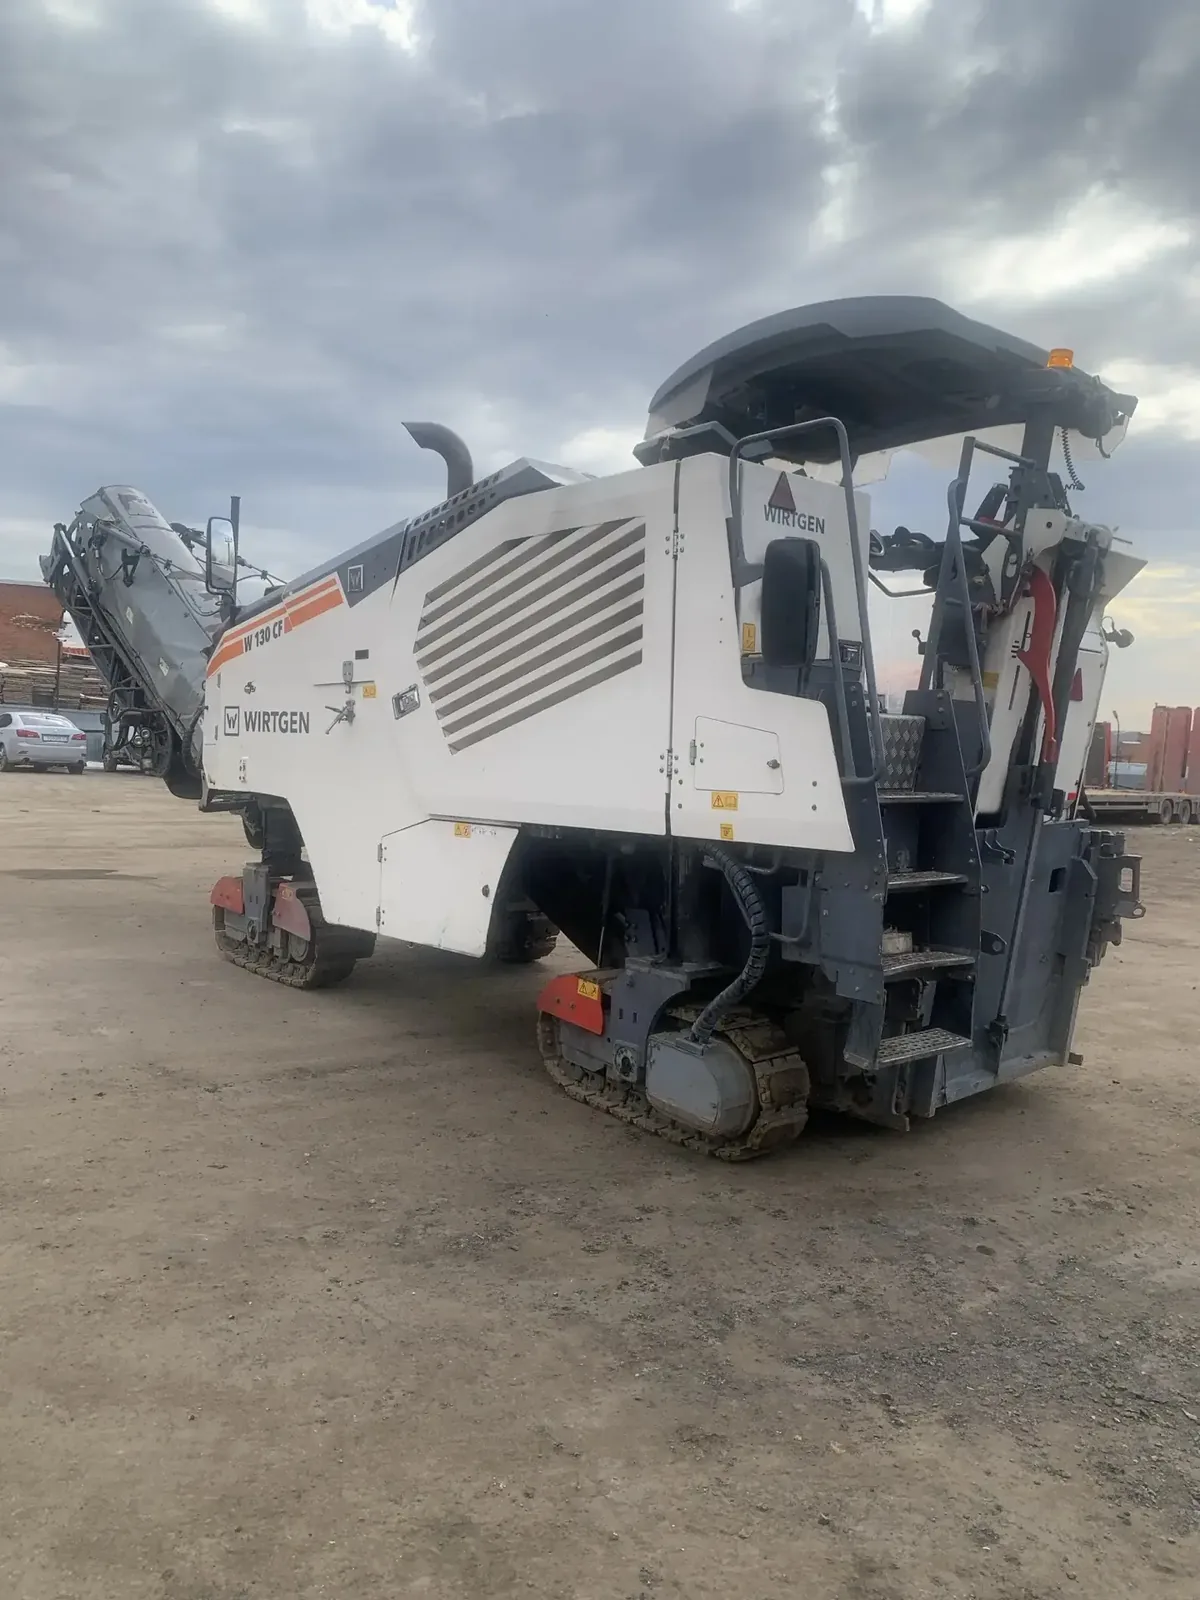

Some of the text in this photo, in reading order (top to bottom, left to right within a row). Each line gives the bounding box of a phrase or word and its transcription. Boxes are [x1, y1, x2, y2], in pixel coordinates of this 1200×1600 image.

[763, 504, 825, 534] WIRTGEN
[244, 619, 283, 653] W 130 CF
[244, 710, 310, 734] WIRTGEN
